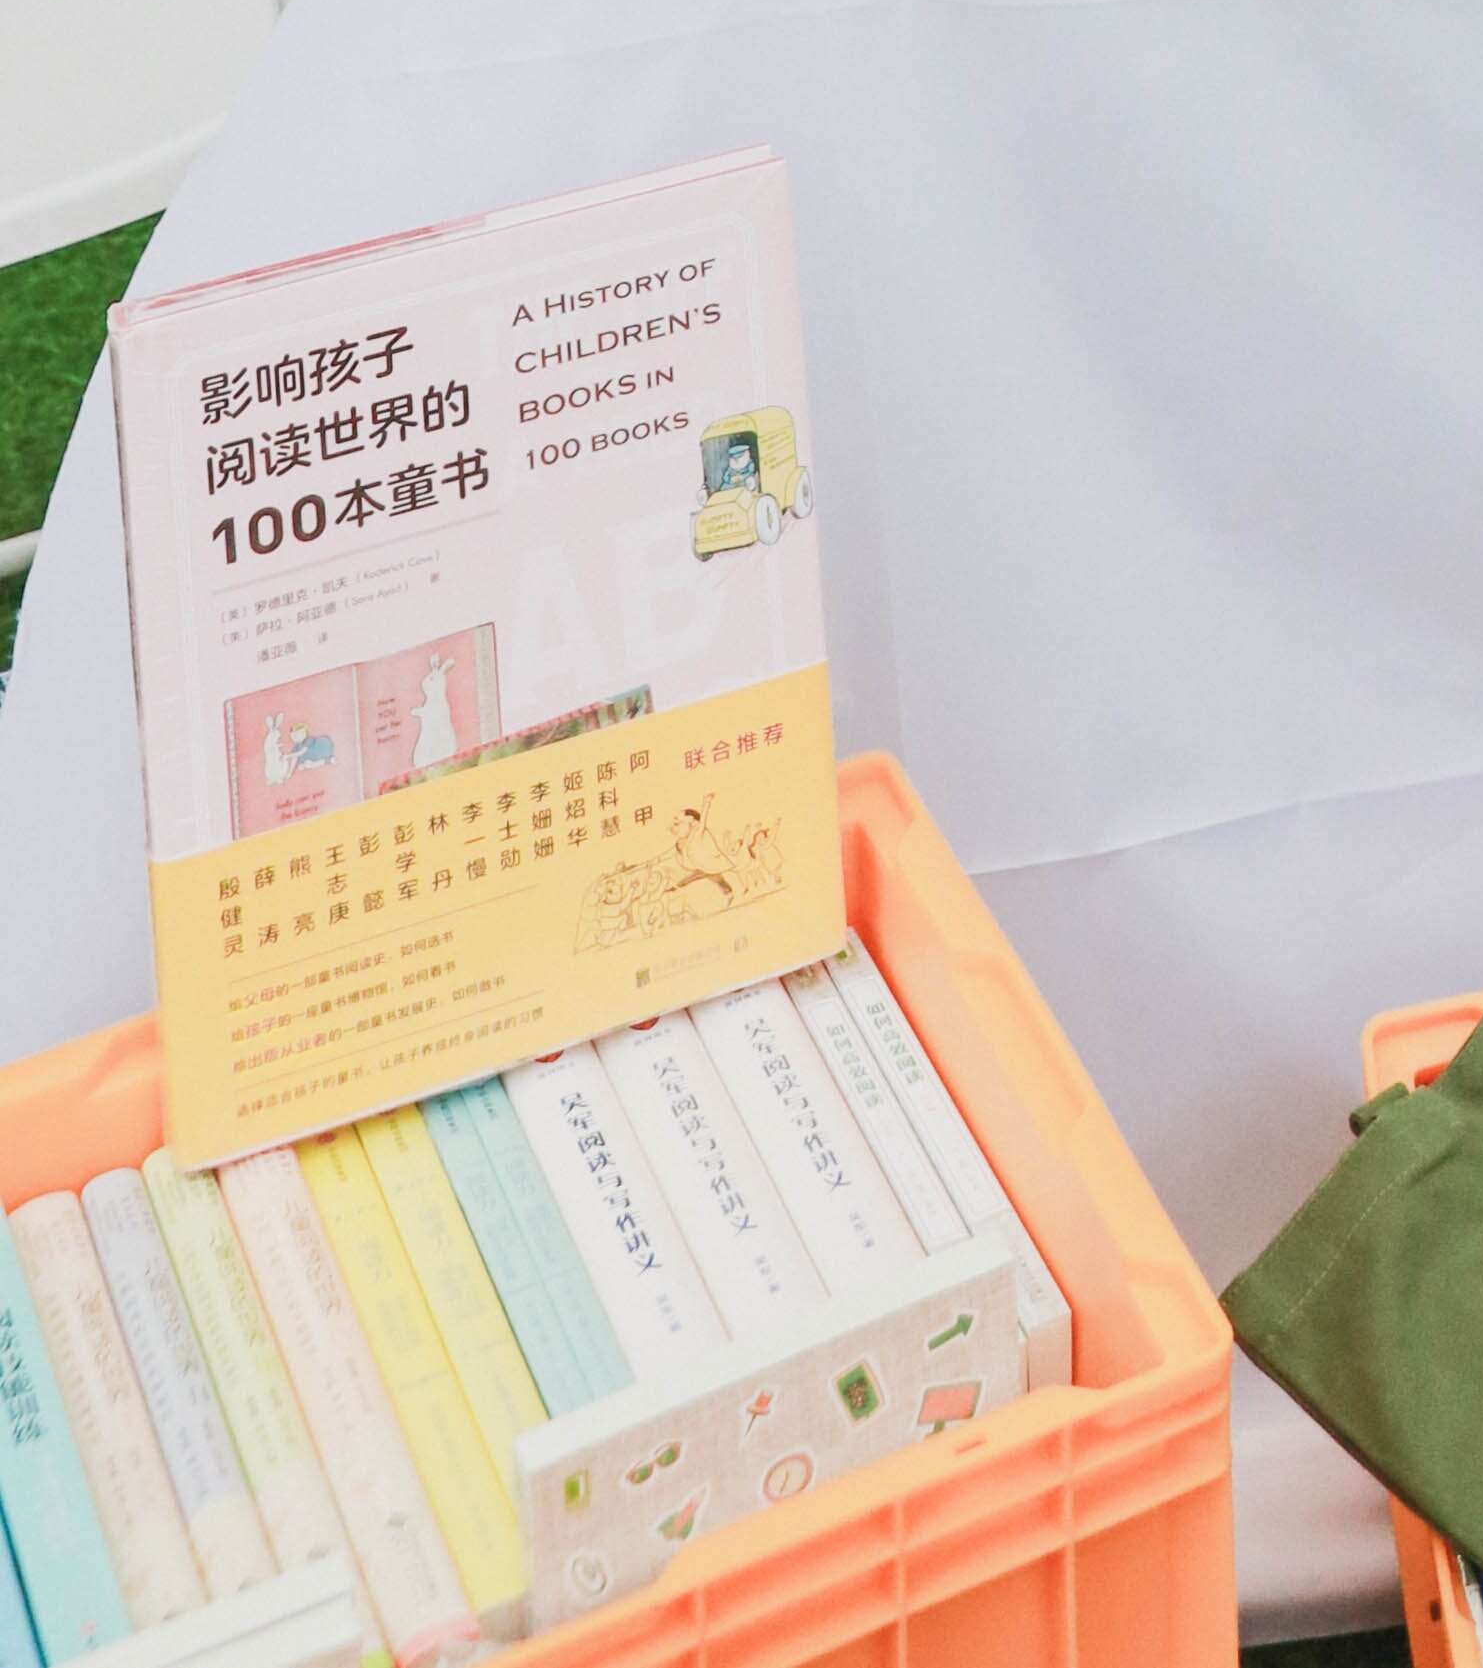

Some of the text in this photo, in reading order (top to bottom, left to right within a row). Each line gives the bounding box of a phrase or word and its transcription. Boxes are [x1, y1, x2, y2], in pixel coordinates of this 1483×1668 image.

[512, 257, 717, 328] A HISTORY OF
[513, 302, 724, 375] CHILDREN'S
[199, 326, 413, 426] 影响孩子
[517, 365, 675, 424] BOOKS IN
[206, 380, 472, 496] 阅读世界的
[525, 411, 690, 470] 100 BOOKS
[212, 448, 490, 565] 100本童书
[683, 722, 786, 770] 联合推荐
